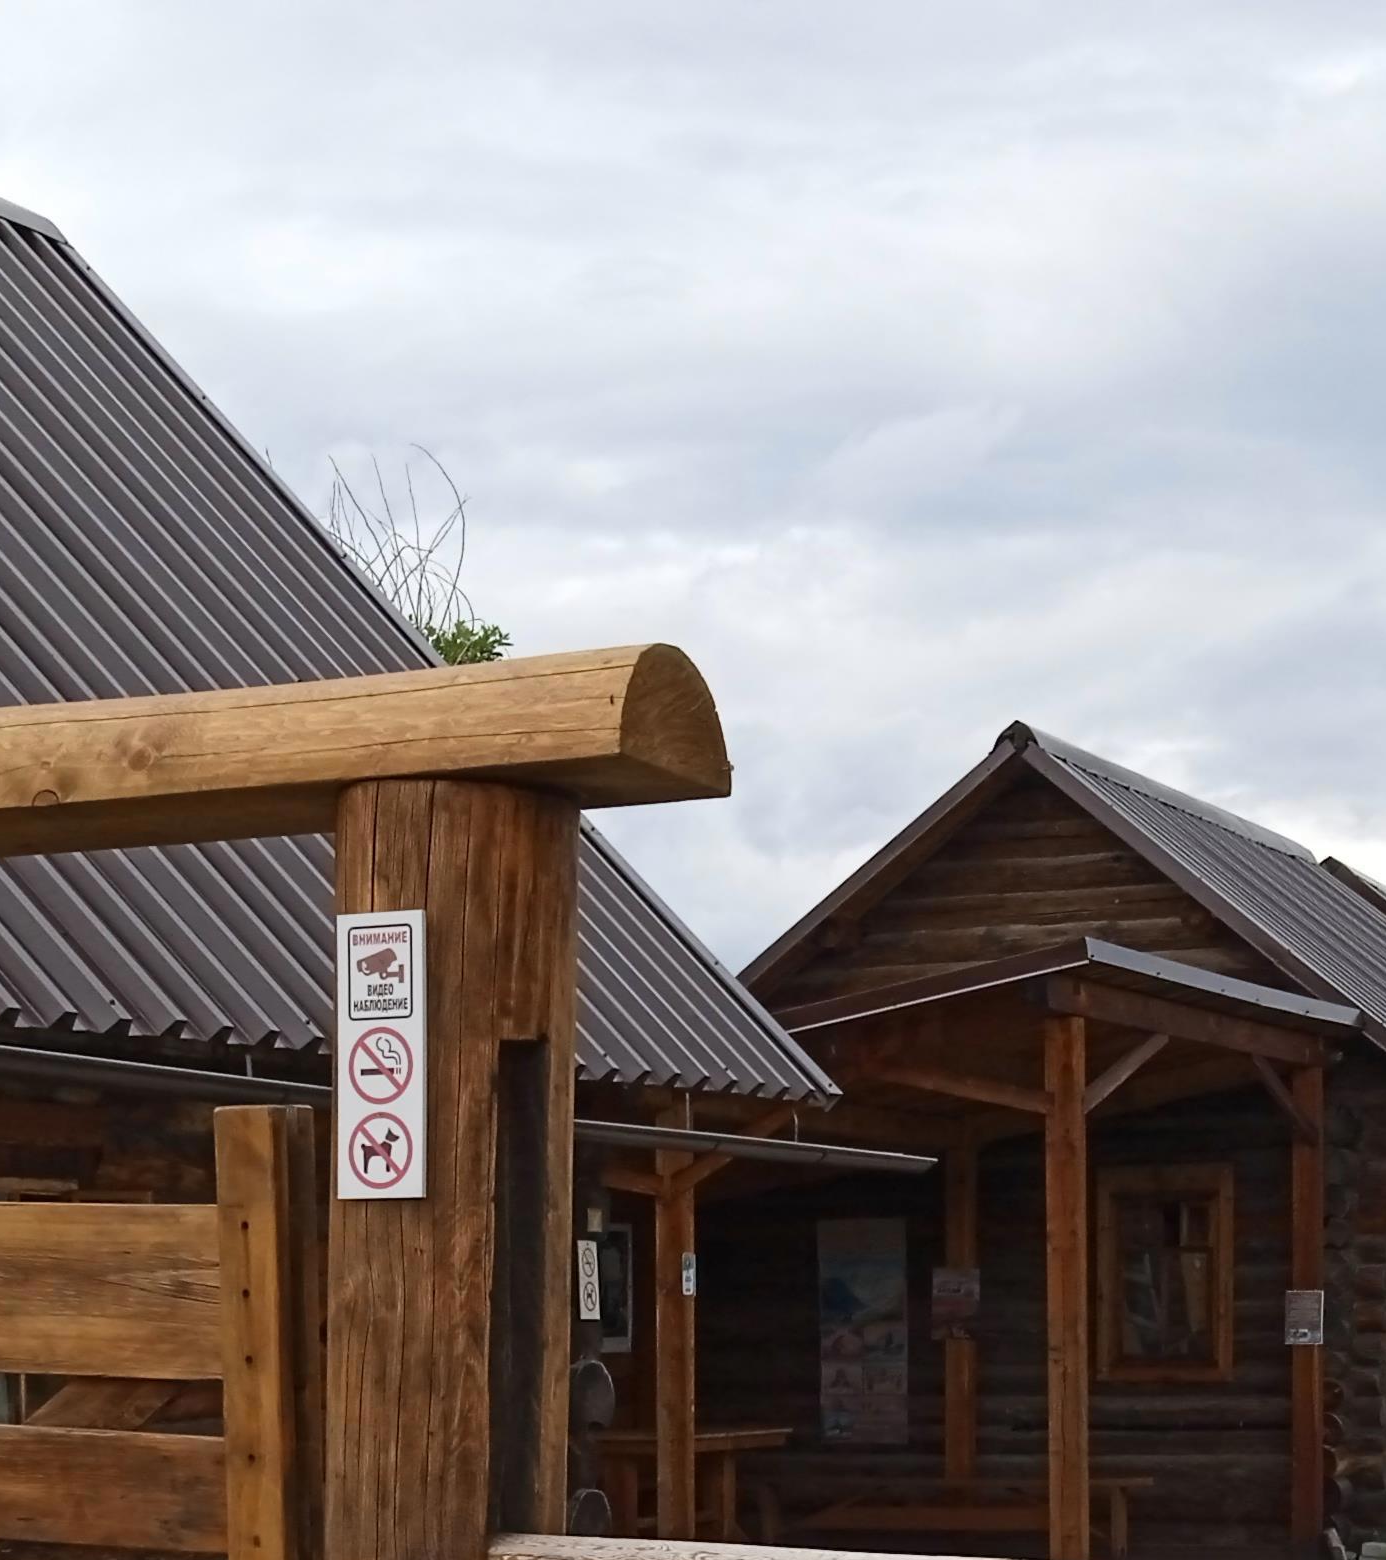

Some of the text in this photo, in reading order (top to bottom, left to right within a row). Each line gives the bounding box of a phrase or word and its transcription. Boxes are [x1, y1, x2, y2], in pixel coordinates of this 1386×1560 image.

[352, 931, 408, 945] ВНИМАНИЕ
[367, 983, 394, 997] ВИДЕО
[353, 997, 409, 1012] НАБЛЮДЕНИЕ
